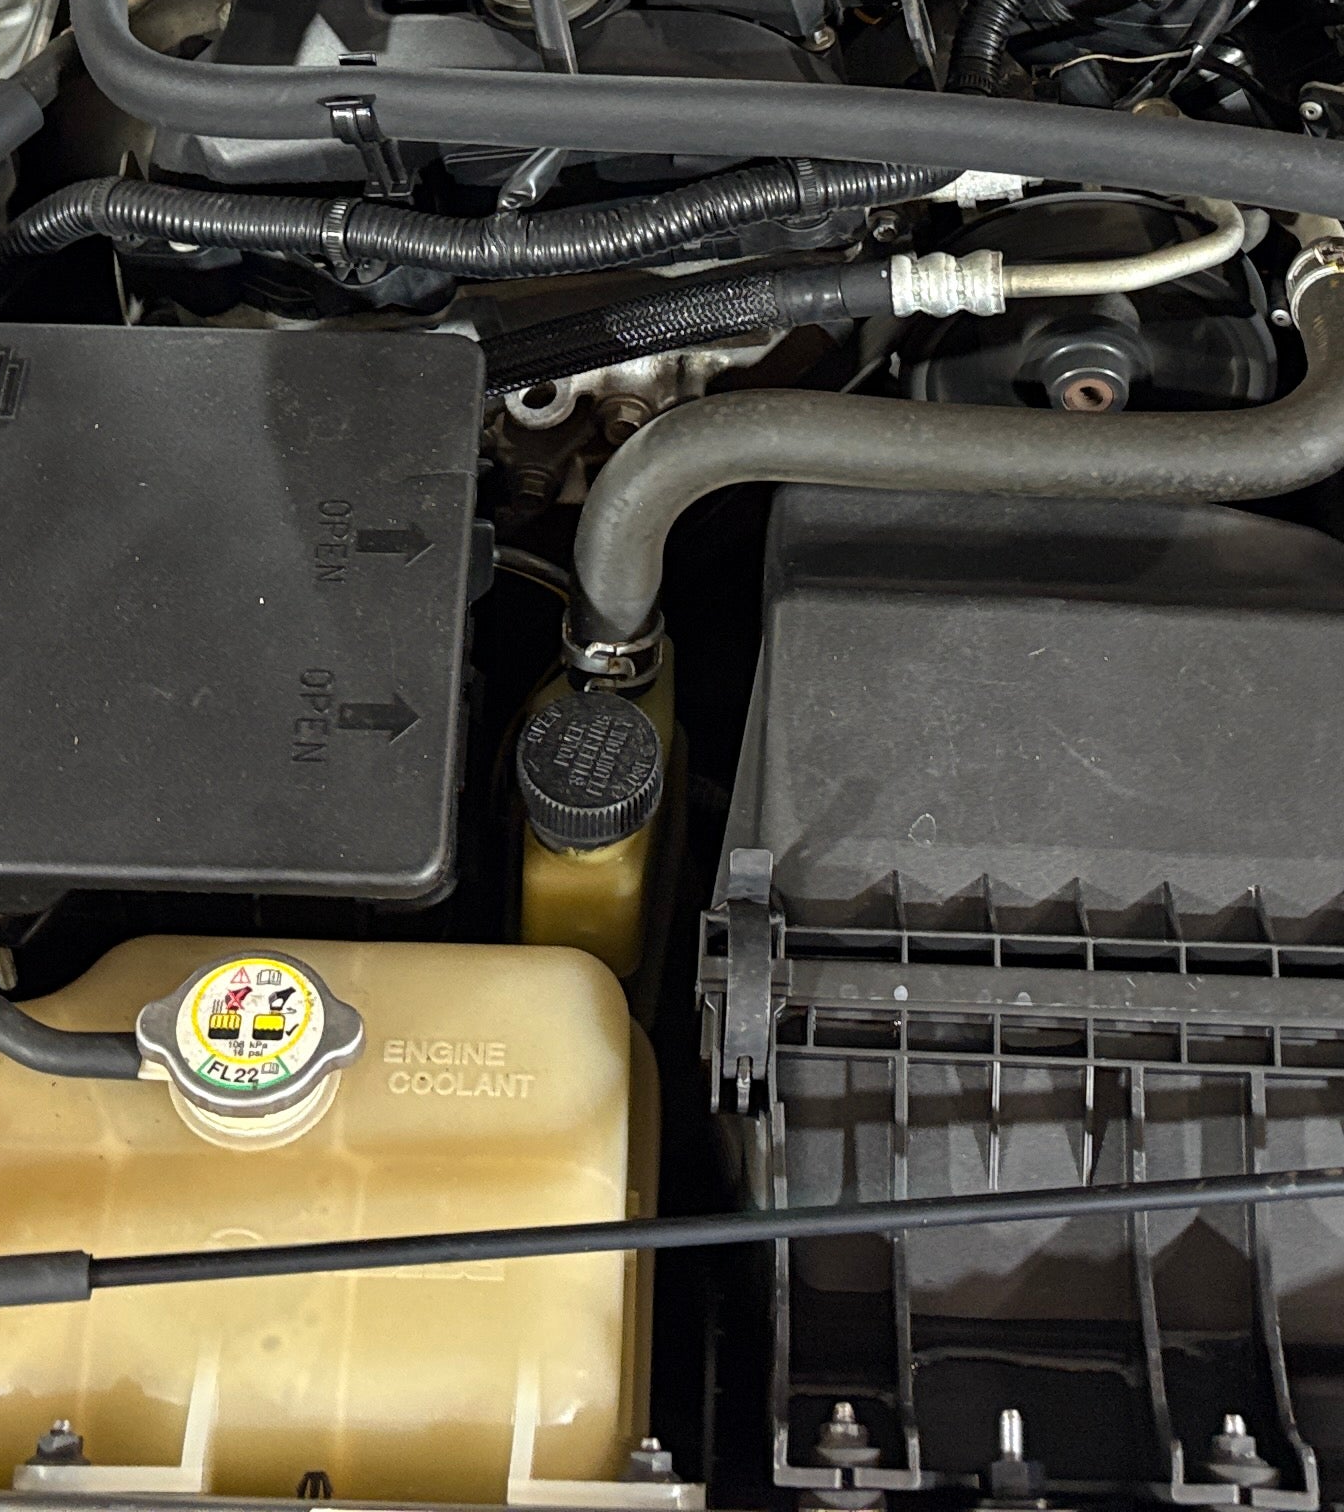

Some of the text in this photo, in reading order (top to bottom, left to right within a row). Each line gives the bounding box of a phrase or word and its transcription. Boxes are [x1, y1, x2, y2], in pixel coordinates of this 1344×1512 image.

[314, 499, 354, 584] OPEN
[290, 667, 336, 764] OPEN
[248, 1049, 264, 1059] psi
[249, 1040, 268, 1049] kPa
[383, 1039, 507, 1067] ENGINE
[206, 1060, 260, 1084] FL22
[387, 1069, 536, 1099] COOLANT
